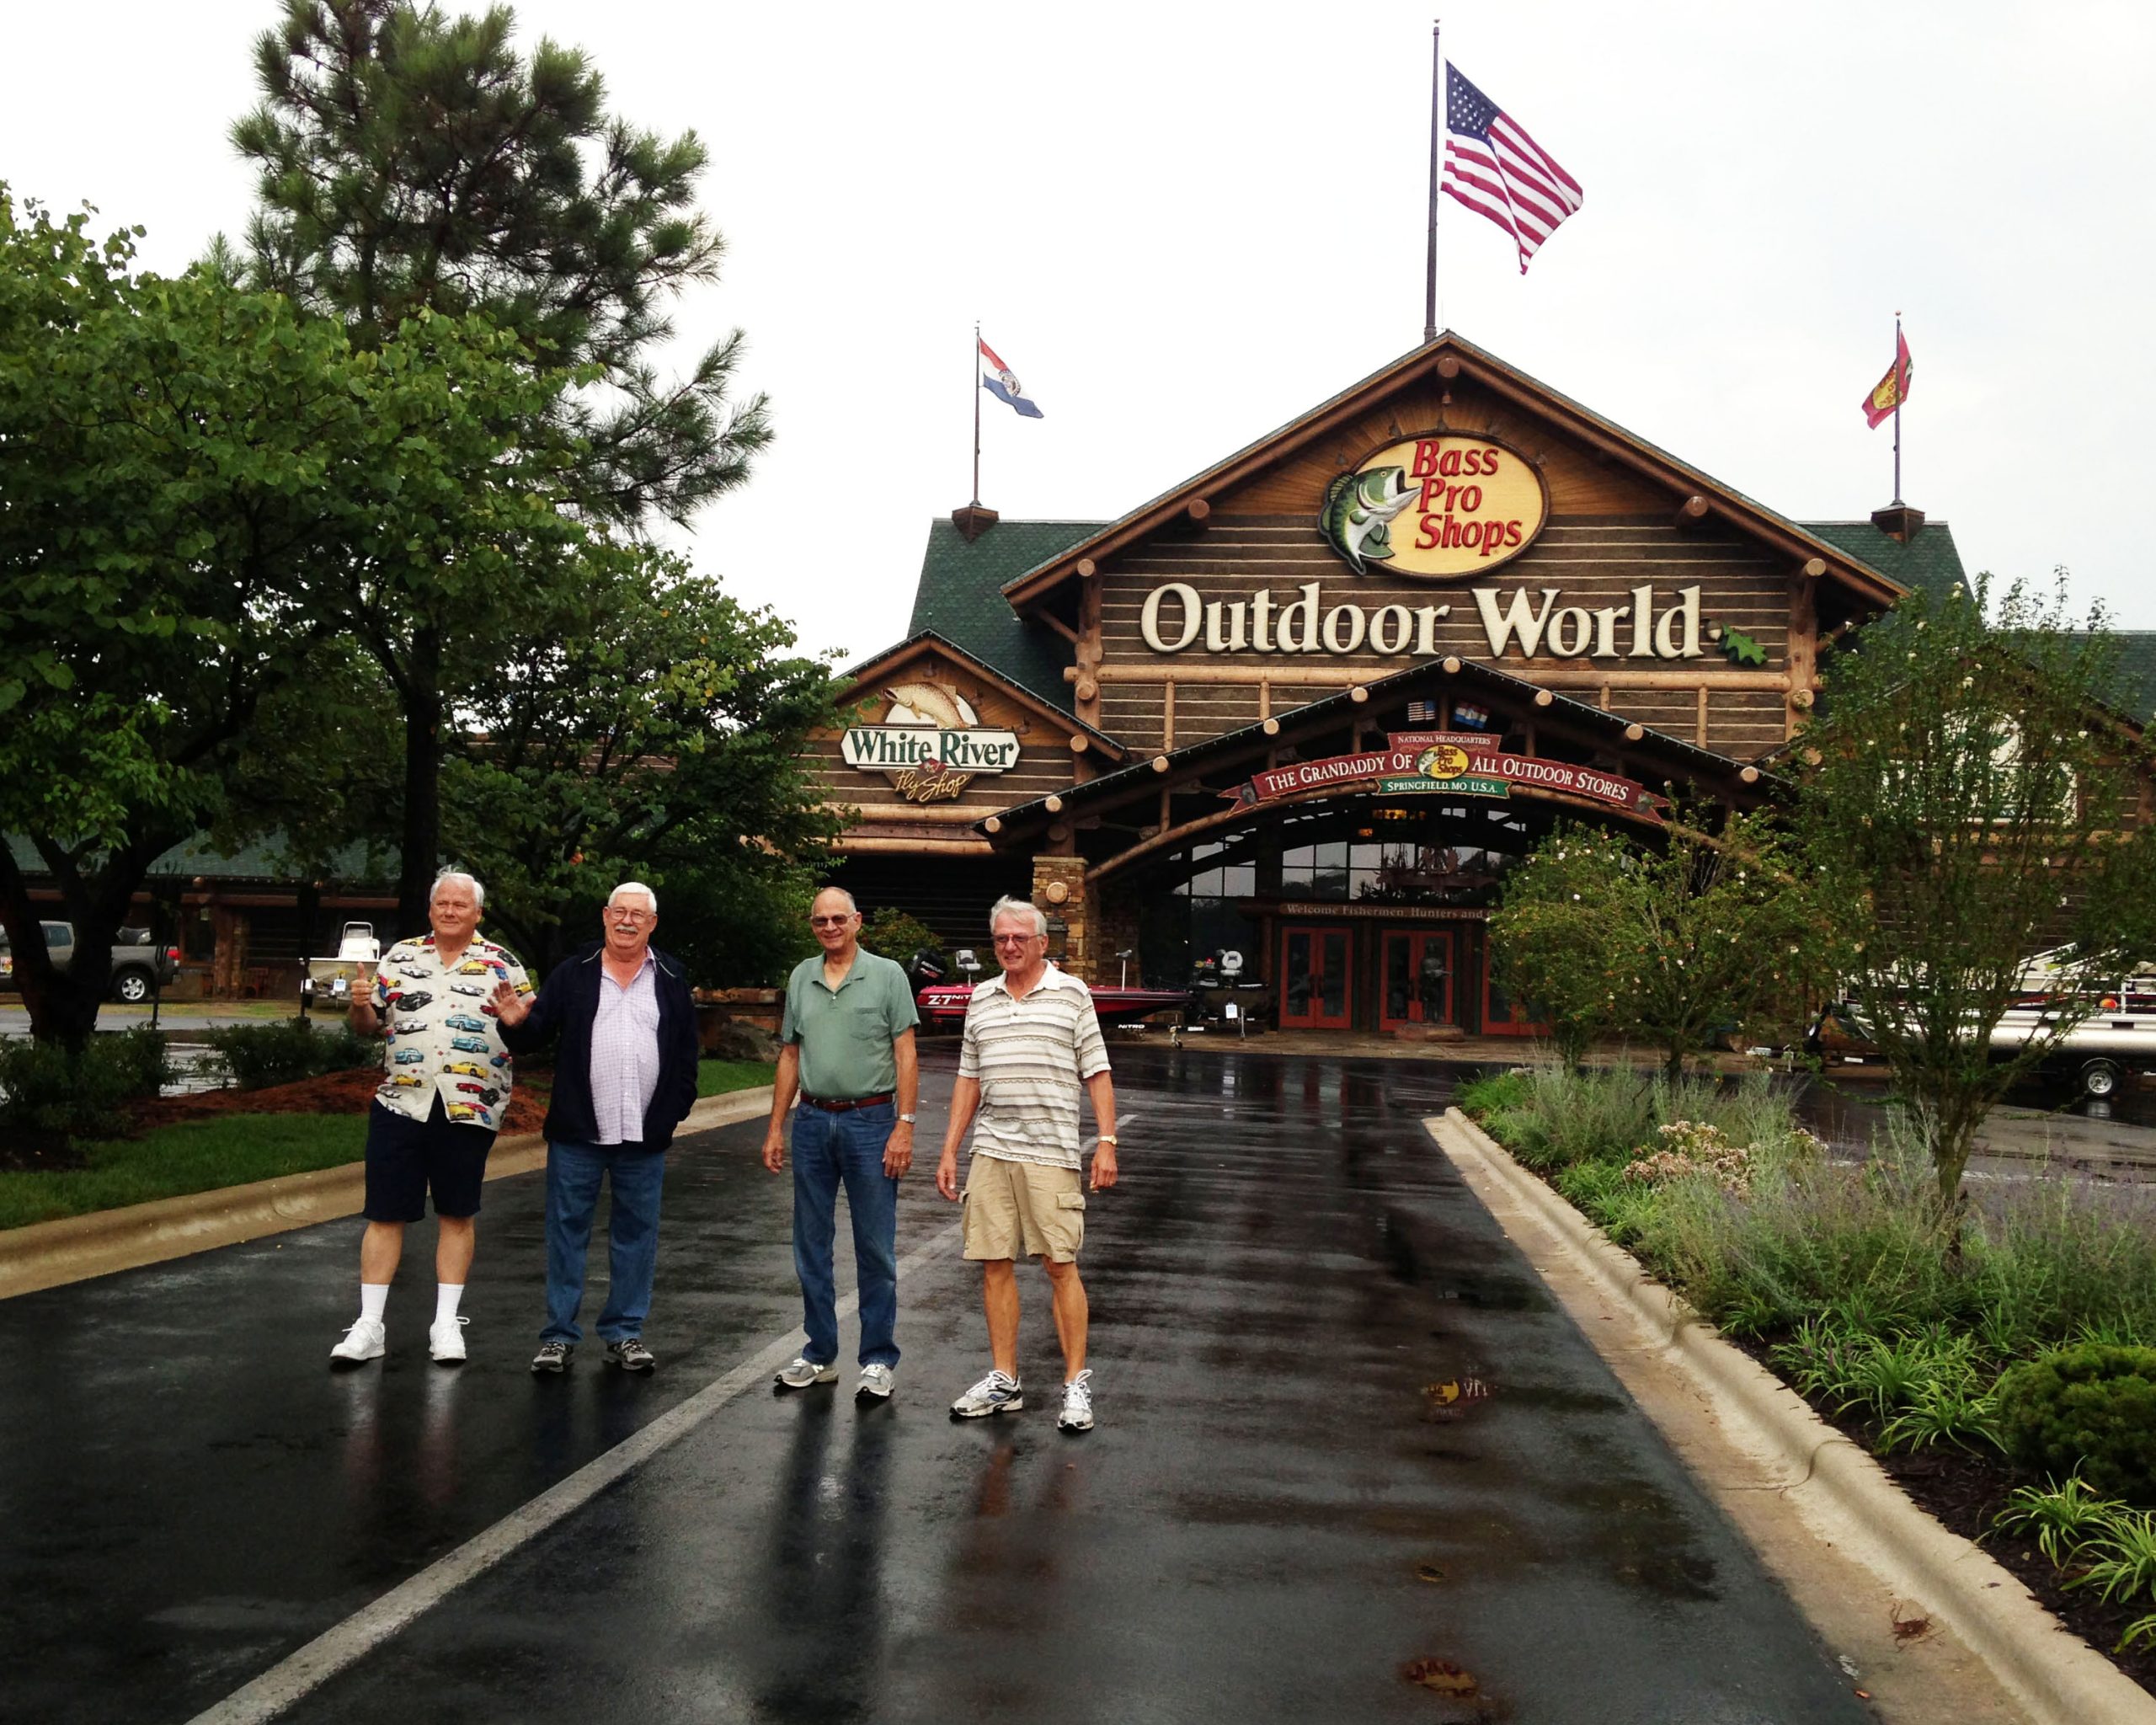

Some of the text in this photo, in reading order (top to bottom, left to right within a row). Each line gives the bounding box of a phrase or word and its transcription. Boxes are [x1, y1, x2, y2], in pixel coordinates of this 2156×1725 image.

[1409, 440, 1500, 478] Bass
[1416, 478, 1483, 513] Pro
[1415, 514, 1523, 557] Shops
[1140, 582, 1705, 660] Outdoor World
[849, 729, 1015, 768] White River
[1397, 734, 1492, 745] NATIONAL HEADQUARTERS
[1438, 745, 1458, 756] Bass
[895, 769, 971, 802] Fly Shop
[1265, 753, 1629, 801] THE GRANDADDY OF ALL OUTDOOR STORES
[1437, 765, 1463, 775] Shops
[1451, 782, 1467, 791] MO
[1470, 782, 1498, 793] U.S.A.
[1287, 903, 1339, 915] Welcome
[1411, 907, 1458, 919] Hunters
[1461, 910, 1483, 919] and
